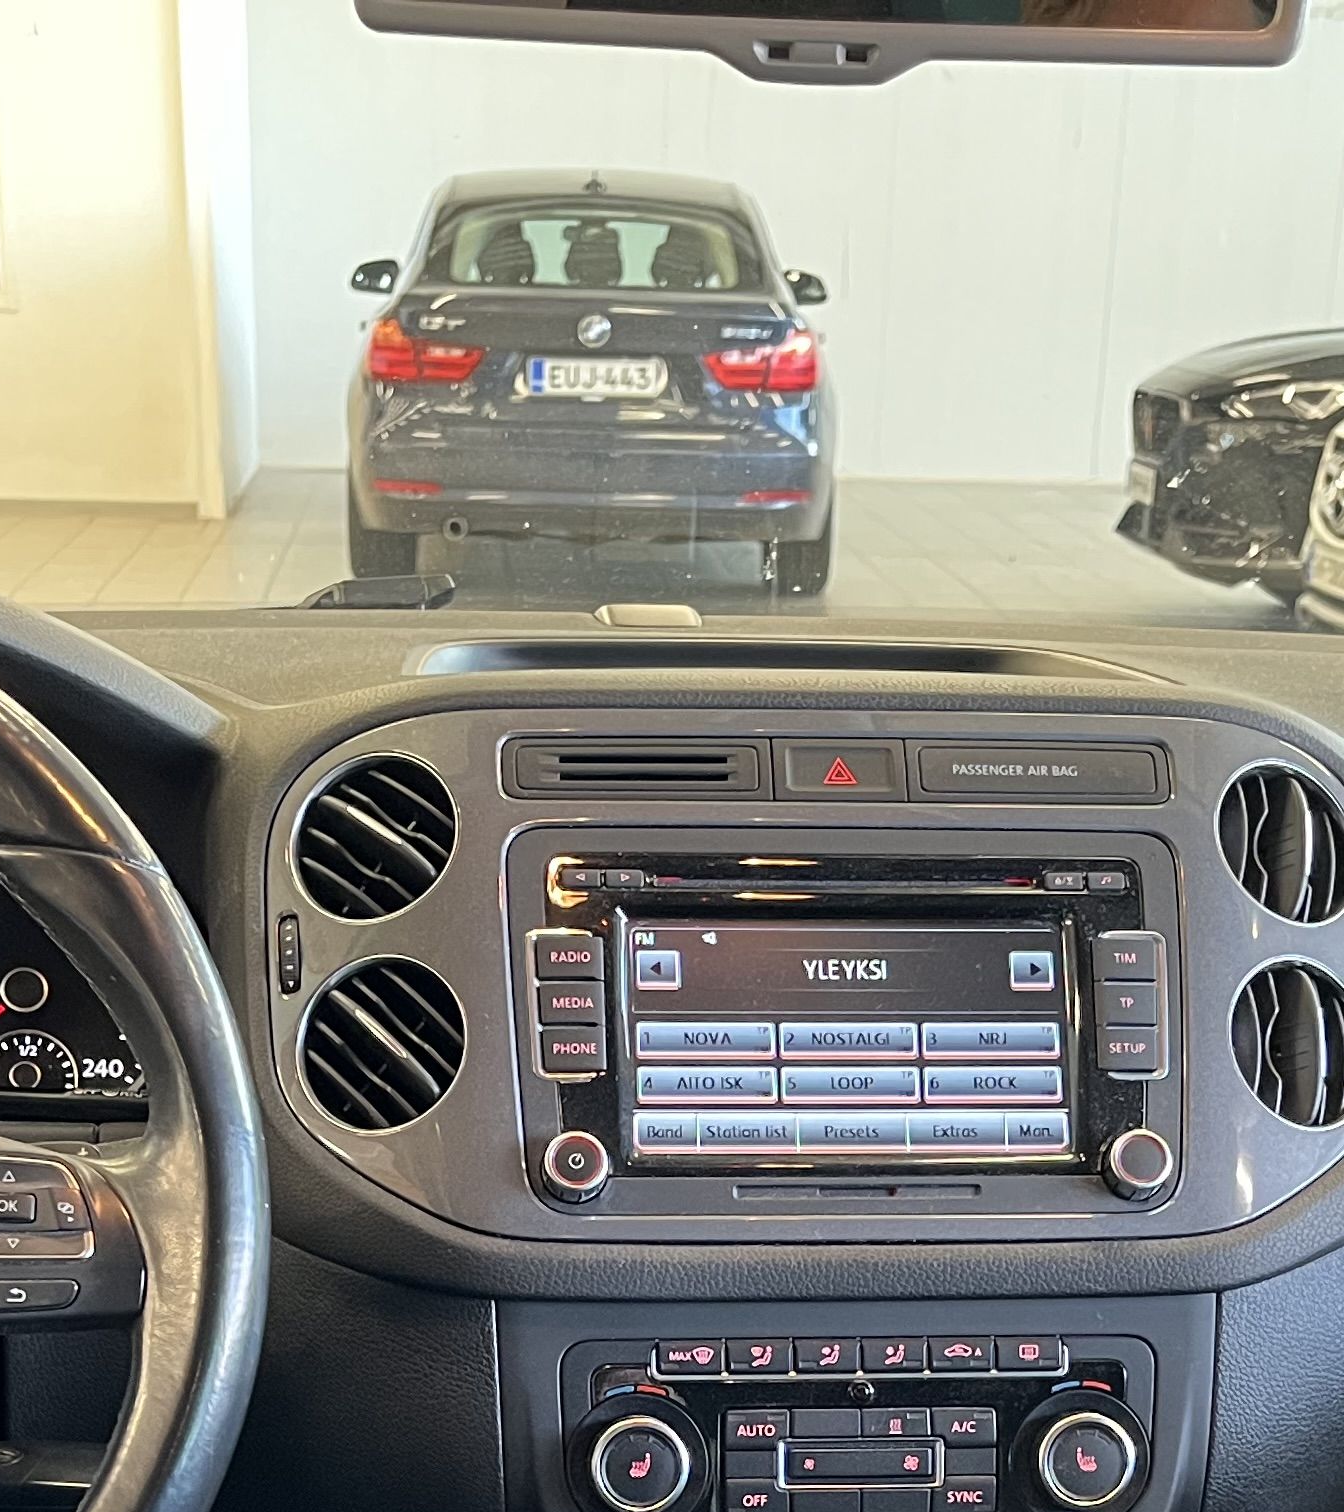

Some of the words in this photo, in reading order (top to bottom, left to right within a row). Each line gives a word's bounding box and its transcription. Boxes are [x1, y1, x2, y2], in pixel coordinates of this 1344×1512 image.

[548, 358, 651, 391] EUJ-443
[952, 763, 1023, 777] PASSENGER
[1027, 765, 1049, 777] AIR
[1052, 765, 1078, 777] BAG
[634, 932, 655, 946] FM
[550, 951, 591, 963] RADIO
[1113, 952, 1137, 964] TIM
[802, 959, 887, 981] YLEYKSI
[552, 997, 594, 1009] MEDIA
[1119, 997, 1135, 1008] TP
[683, 1031, 732, 1045] NOVA
[786, 1032, 795, 1046] 2
[811, 1032, 890, 1046] NOSTALGI
[929, 1032, 937, 1046] 3
[978, 1032, 1007, 1046] NRJ
[552, 1043, 598, 1055] PHONE
[1108, 1042, 1146, 1054] SETUP
[82, 1058, 124, 1079] 240
[643, 1076, 653, 1090] 4
[676, 1076, 715, 1090] AITO
[720, 1076, 743, 1090] ISK
[787, 1076, 797, 1090] 5
[830, 1076, 874, 1090] LOOP
[930, 1076, 940, 1090] 6
[973, 1076, 1017, 1090] ROCK
[647, 1125, 683, 1139] Band
[706, 1125, 761, 1139] Station
[765, 1124, 787, 1139] list
[824, 1125, 880, 1139] Presets
[932, 1125, 978, 1138] Extras
[668, 1351, 692, 1362] MAX
[736, 1424, 776, 1437] AUTO
[951, 1420, 977, 1433] A/C
[742, 1494, 768, 1507] OFF
[946, 1490, 983, 1503] SYNC
